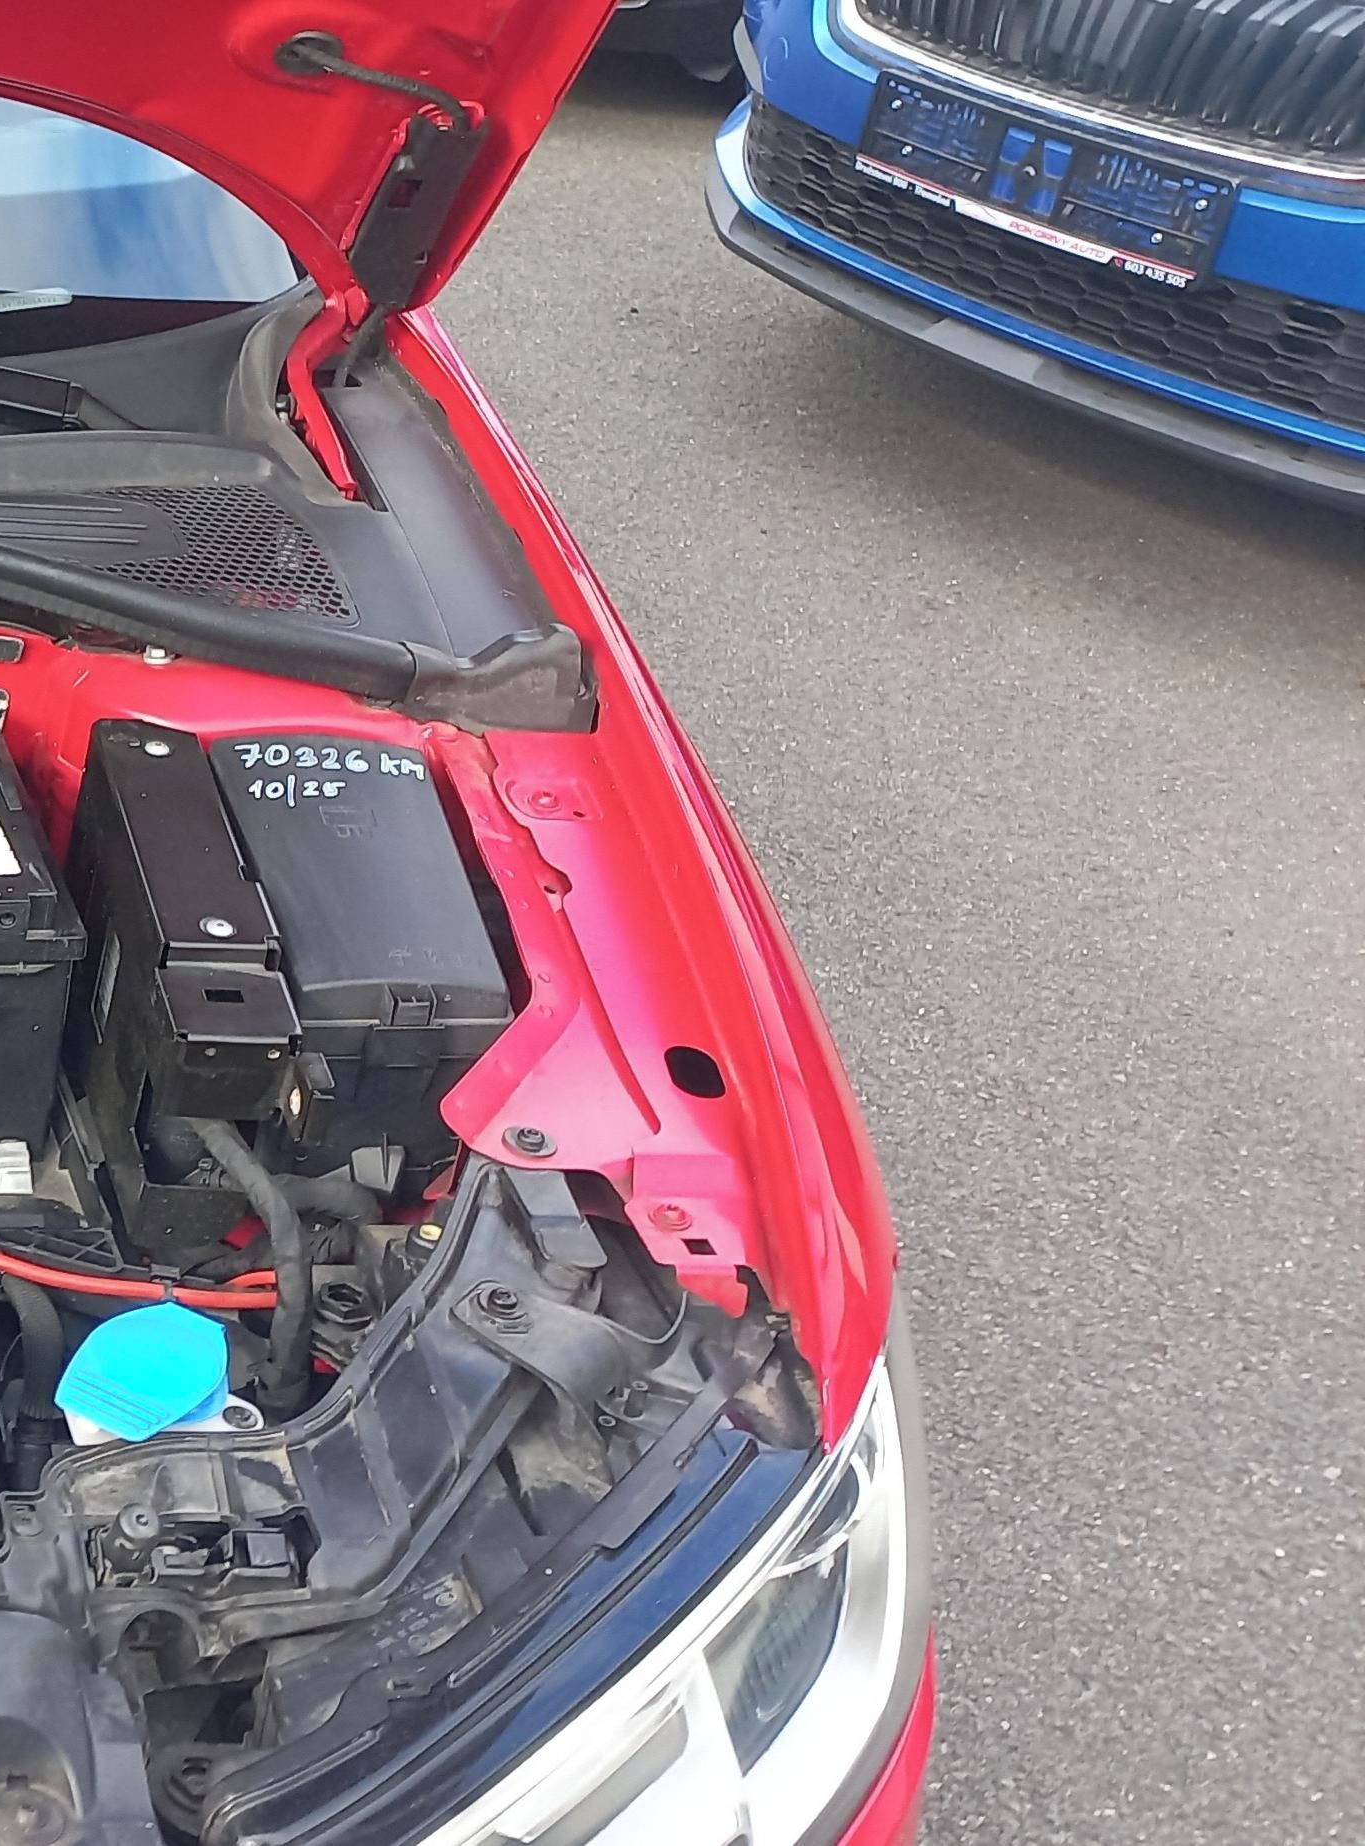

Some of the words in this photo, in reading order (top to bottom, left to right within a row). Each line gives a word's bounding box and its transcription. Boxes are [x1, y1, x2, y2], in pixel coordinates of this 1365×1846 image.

[1070, 241, 1107, 260] AUTO
[1124, 260, 1145, 276] 603
[1166, 274, 1187, 289] 505
[234, 742, 370, 773] 70326
[248, 773, 346, 808] 10/25
